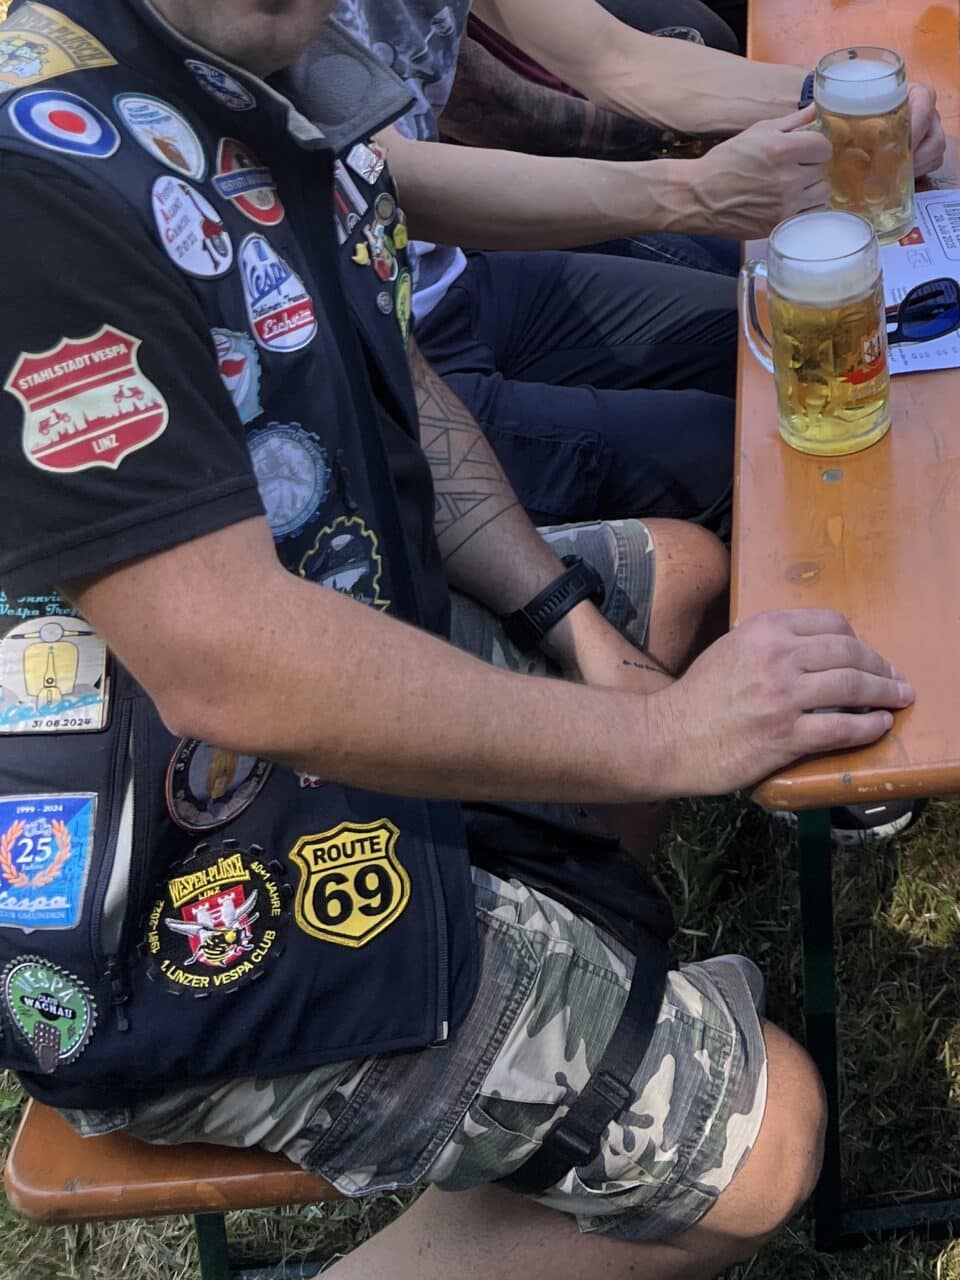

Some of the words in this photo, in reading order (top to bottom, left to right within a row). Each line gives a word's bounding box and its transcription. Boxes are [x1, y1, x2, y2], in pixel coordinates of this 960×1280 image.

[18, 354, 92, 390] STAHLSTADT
[90, 343, 129, 364] VESPA
[92, 434, 119, 453] LINZ
[16, 837, 52, 863] 25
[313, 835, 382, 866] ROUTE
[265, 881, 281, 917] JAHRE
[312, 864, 394, 926] 69
[167, 965, 210, 988] LINZER
[213, 962, 254, 986] VESPA
[251, 930, 276, 962] CLUB
[16, 970, 76, 1002] VESPA
[23, 997, 73, 1018] WACHAU
